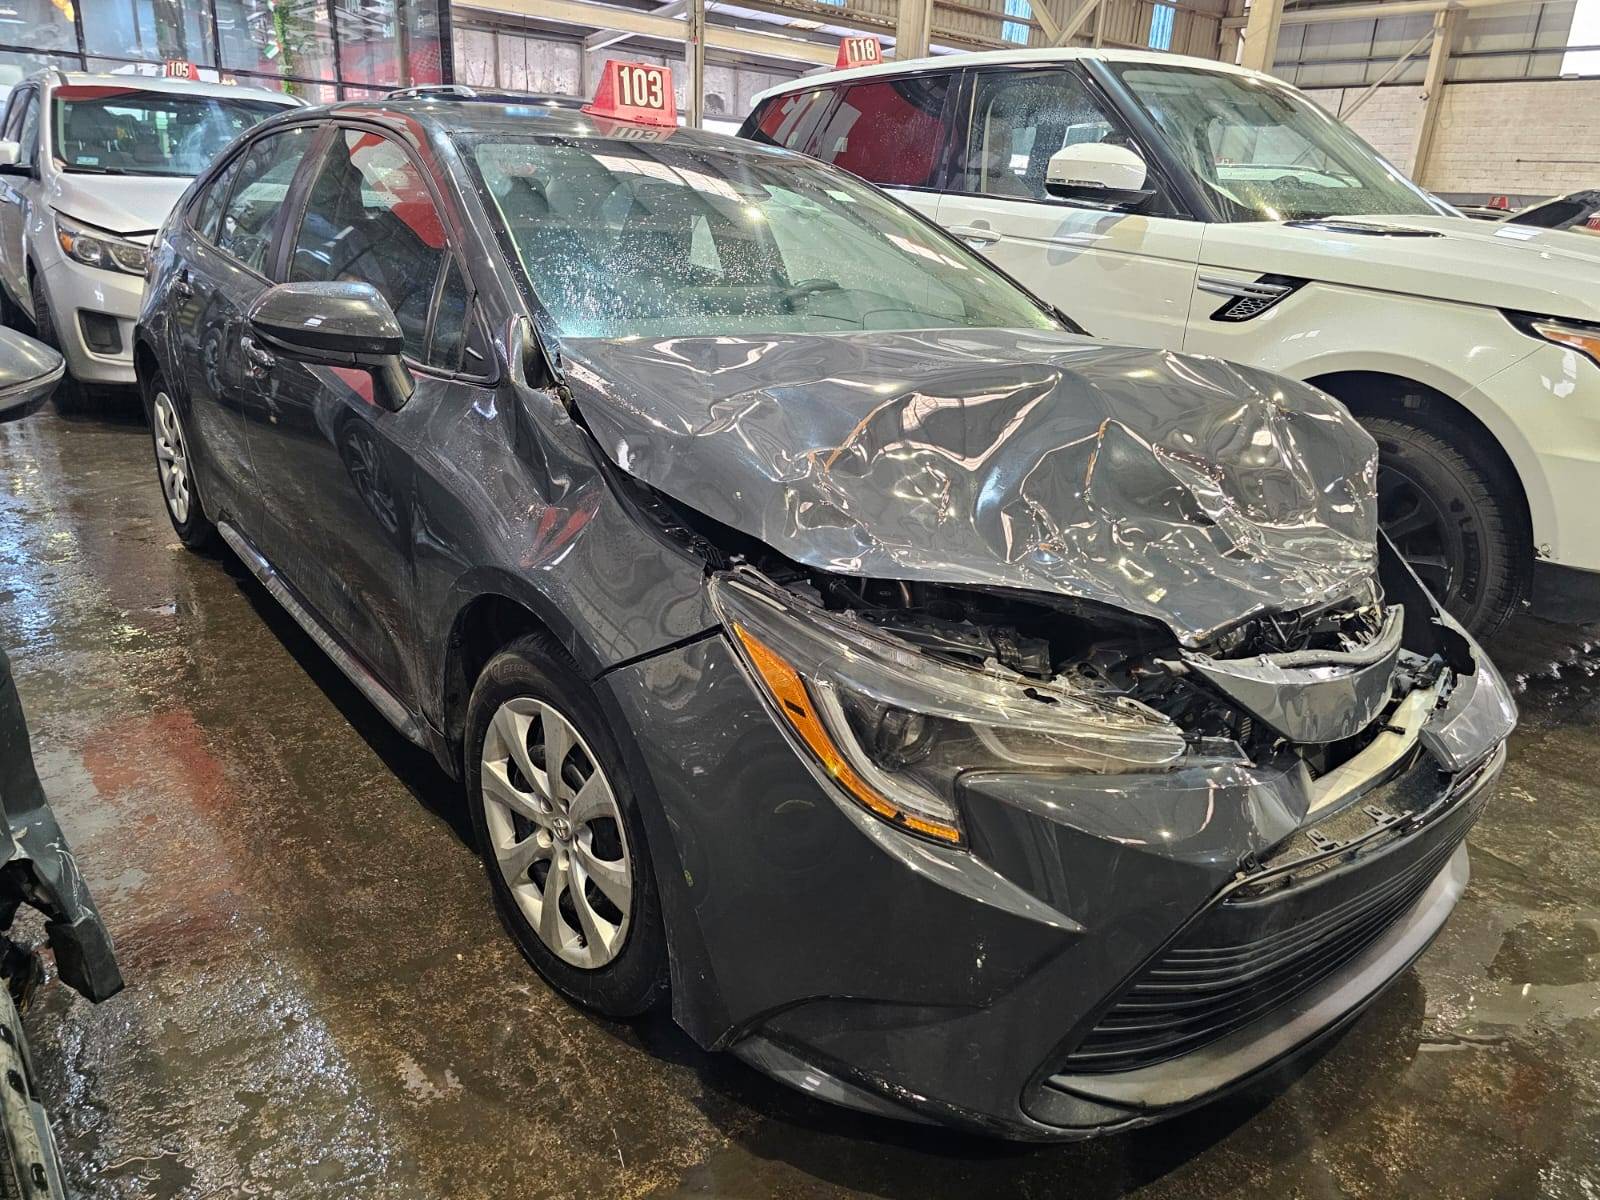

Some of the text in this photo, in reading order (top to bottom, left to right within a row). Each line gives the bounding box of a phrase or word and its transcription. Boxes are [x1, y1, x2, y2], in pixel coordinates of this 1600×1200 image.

[851, 39, 877, 62] 118
[170, 61, 189, 78] 105
[620, 66, 663, 108] 103
